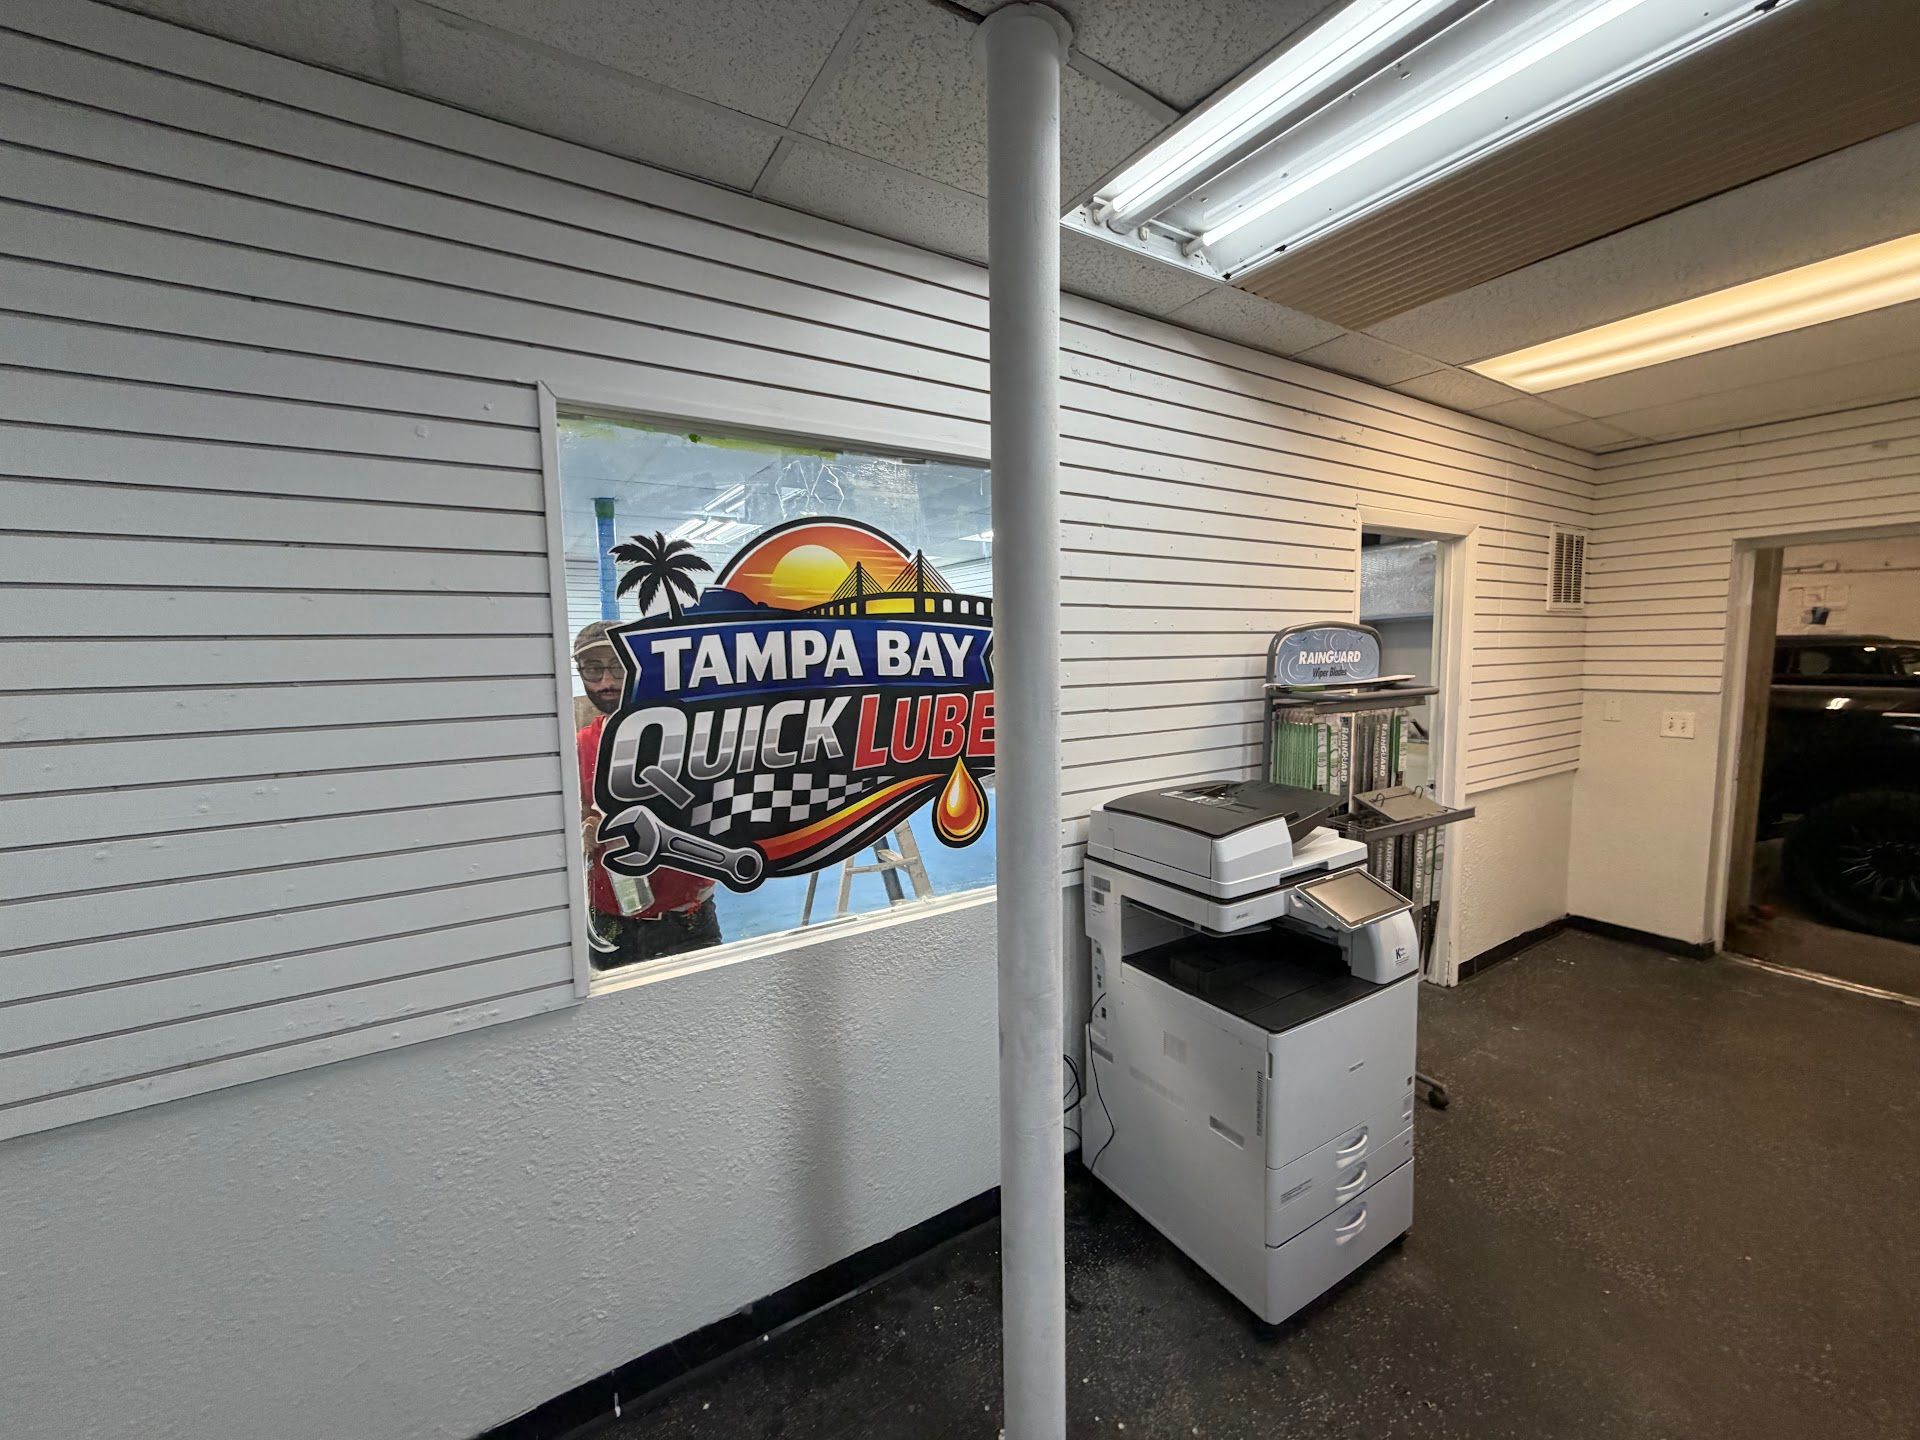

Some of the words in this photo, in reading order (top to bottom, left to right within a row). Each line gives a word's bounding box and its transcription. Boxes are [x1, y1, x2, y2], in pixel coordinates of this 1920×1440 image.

[651, 629, 864, 692] TAMPA
[876, 629, 975, 678] BAY
[1298, 649, 1361, 665] RAINGUARD
[1312, 667, 1328, 679] Wiper
[1329, 665, 1347, 677] Blades
[608, 696, 853, 810] QUICK
[853, 689, 996, 771] LUBE
[1340, 727, 1350, 783] RAINGUARD
[1380, 723, 1388, 777] RAINGUARD
[1415, 833, 1425, 889] RAINGUARD
